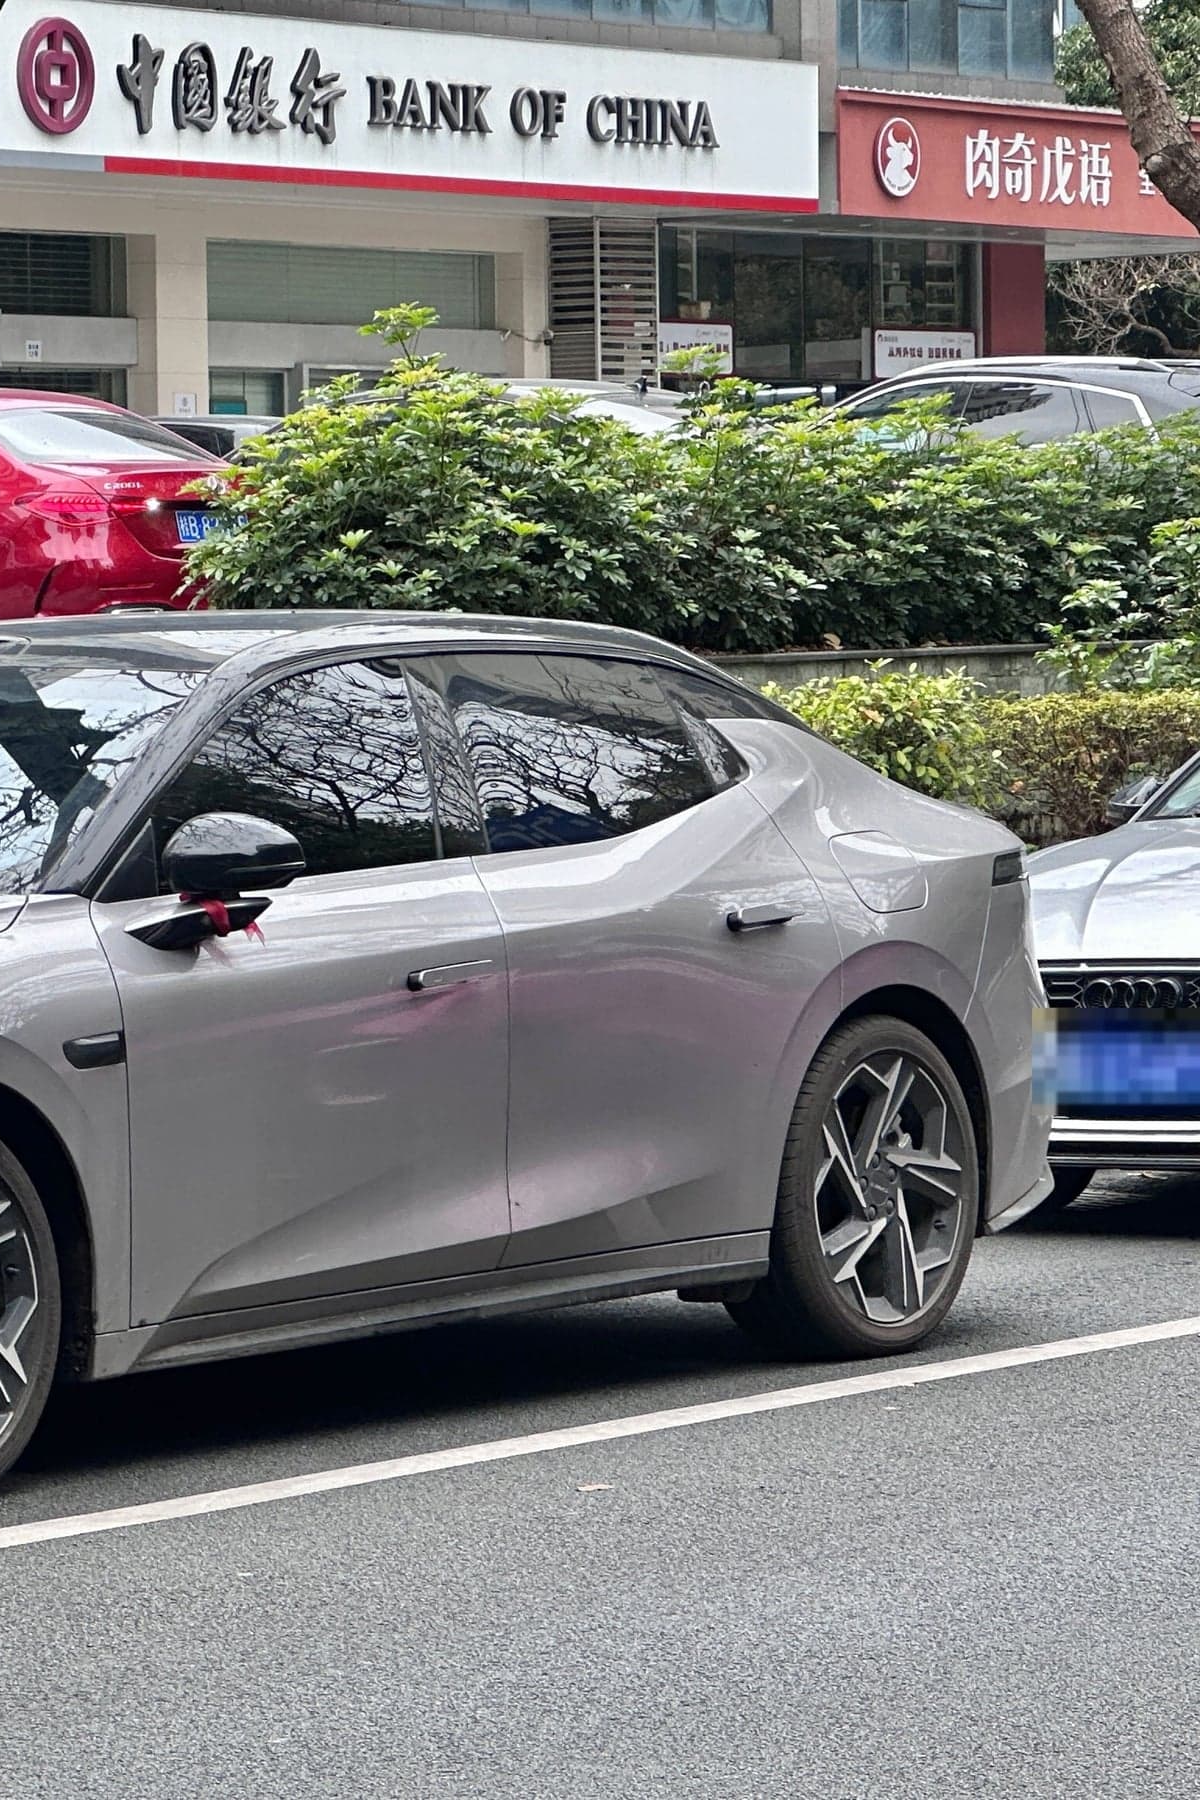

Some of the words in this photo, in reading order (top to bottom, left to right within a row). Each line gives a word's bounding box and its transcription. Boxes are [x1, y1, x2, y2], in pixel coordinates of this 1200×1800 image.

[366, 75, 493, 133] BANK
[509, 87, 567, 138] OF
[586, 94, 720, 148] CHINA
